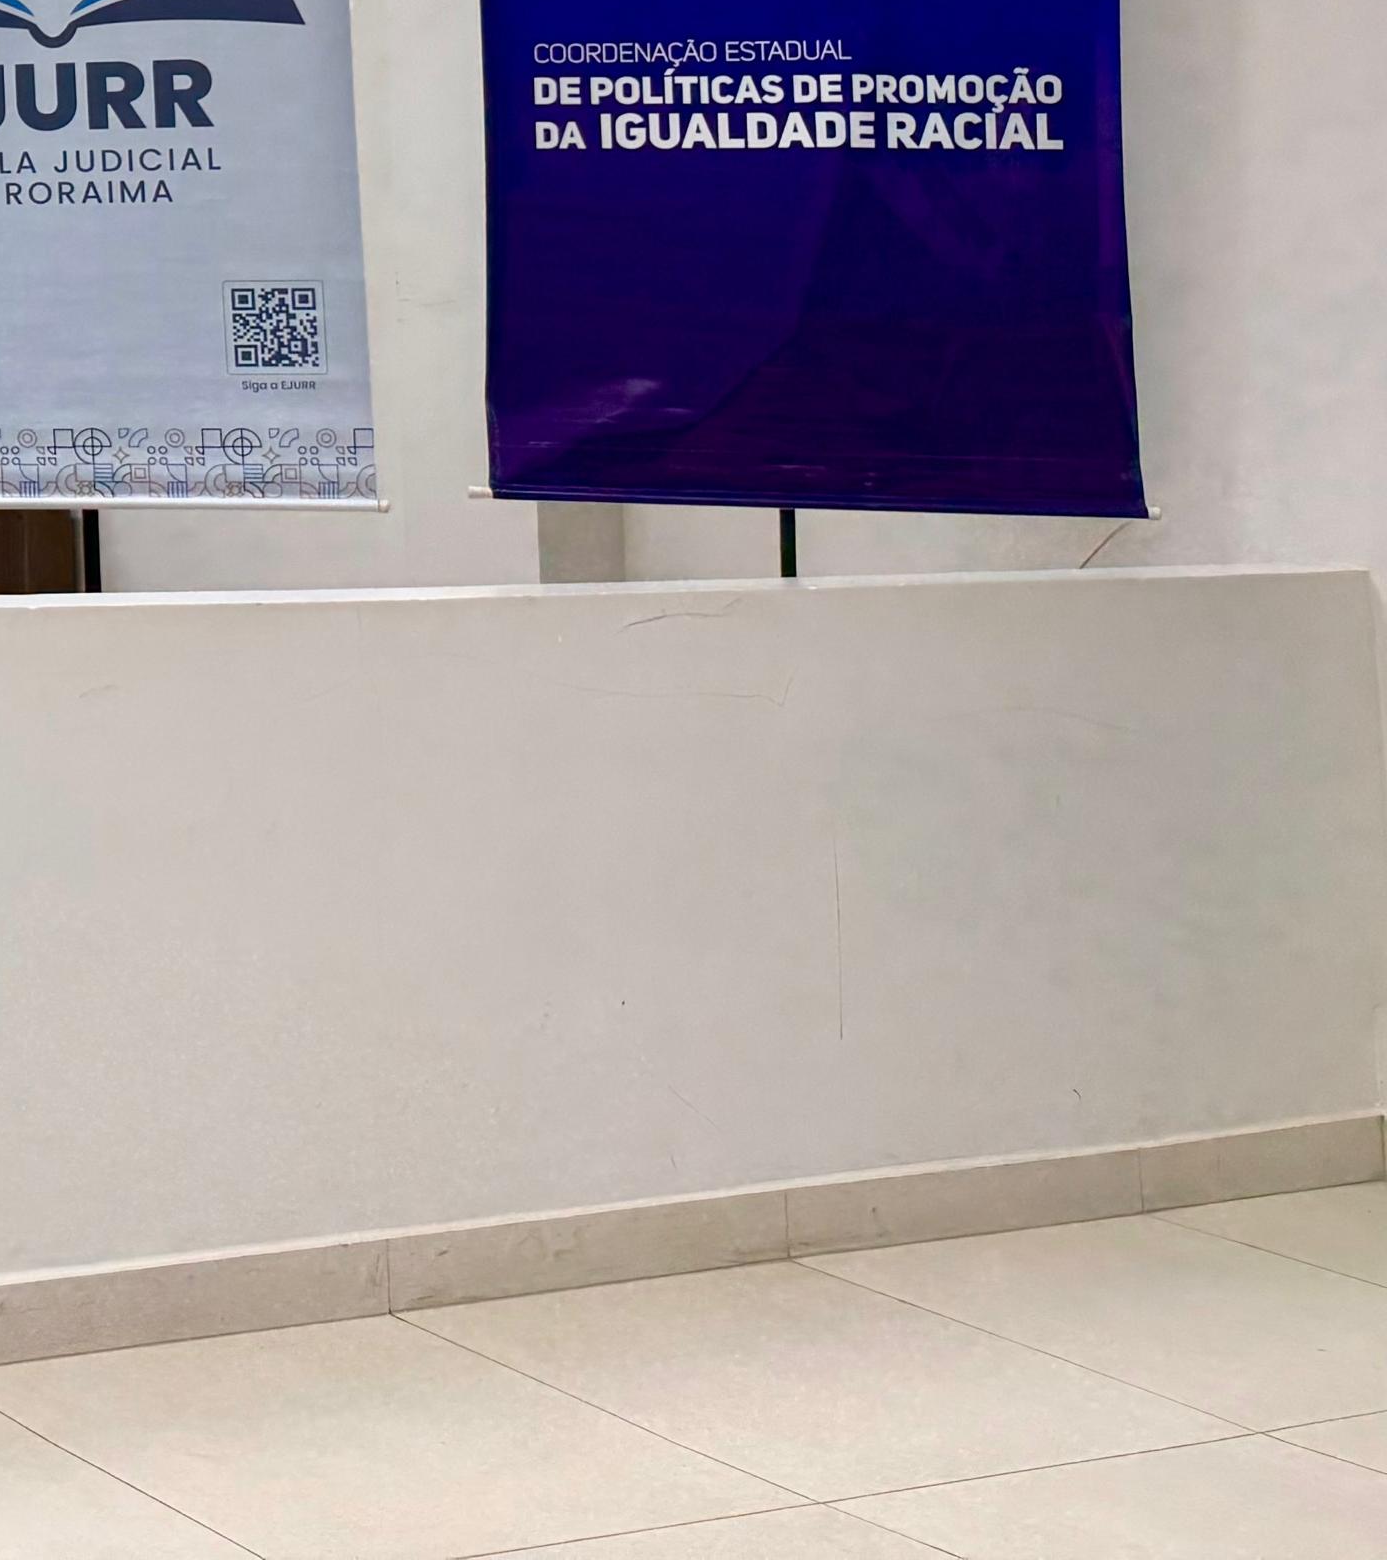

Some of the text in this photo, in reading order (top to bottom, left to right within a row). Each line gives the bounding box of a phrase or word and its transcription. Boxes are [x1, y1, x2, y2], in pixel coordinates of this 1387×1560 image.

[533, 39, 853, 68] COORDENAÇÃO ESTADUAL
[533, 66, 1063, 114] DE POLÍTICAS DE PROMOÇÃO
[535, 111, 1065, 151] DA IGUALDADE RACIAL
[53, 147, 222, 173] JUDICIAL
[5, 179, 174, 205] RORAIMA
[241, 380, 316, 393] Siga a EJURR
